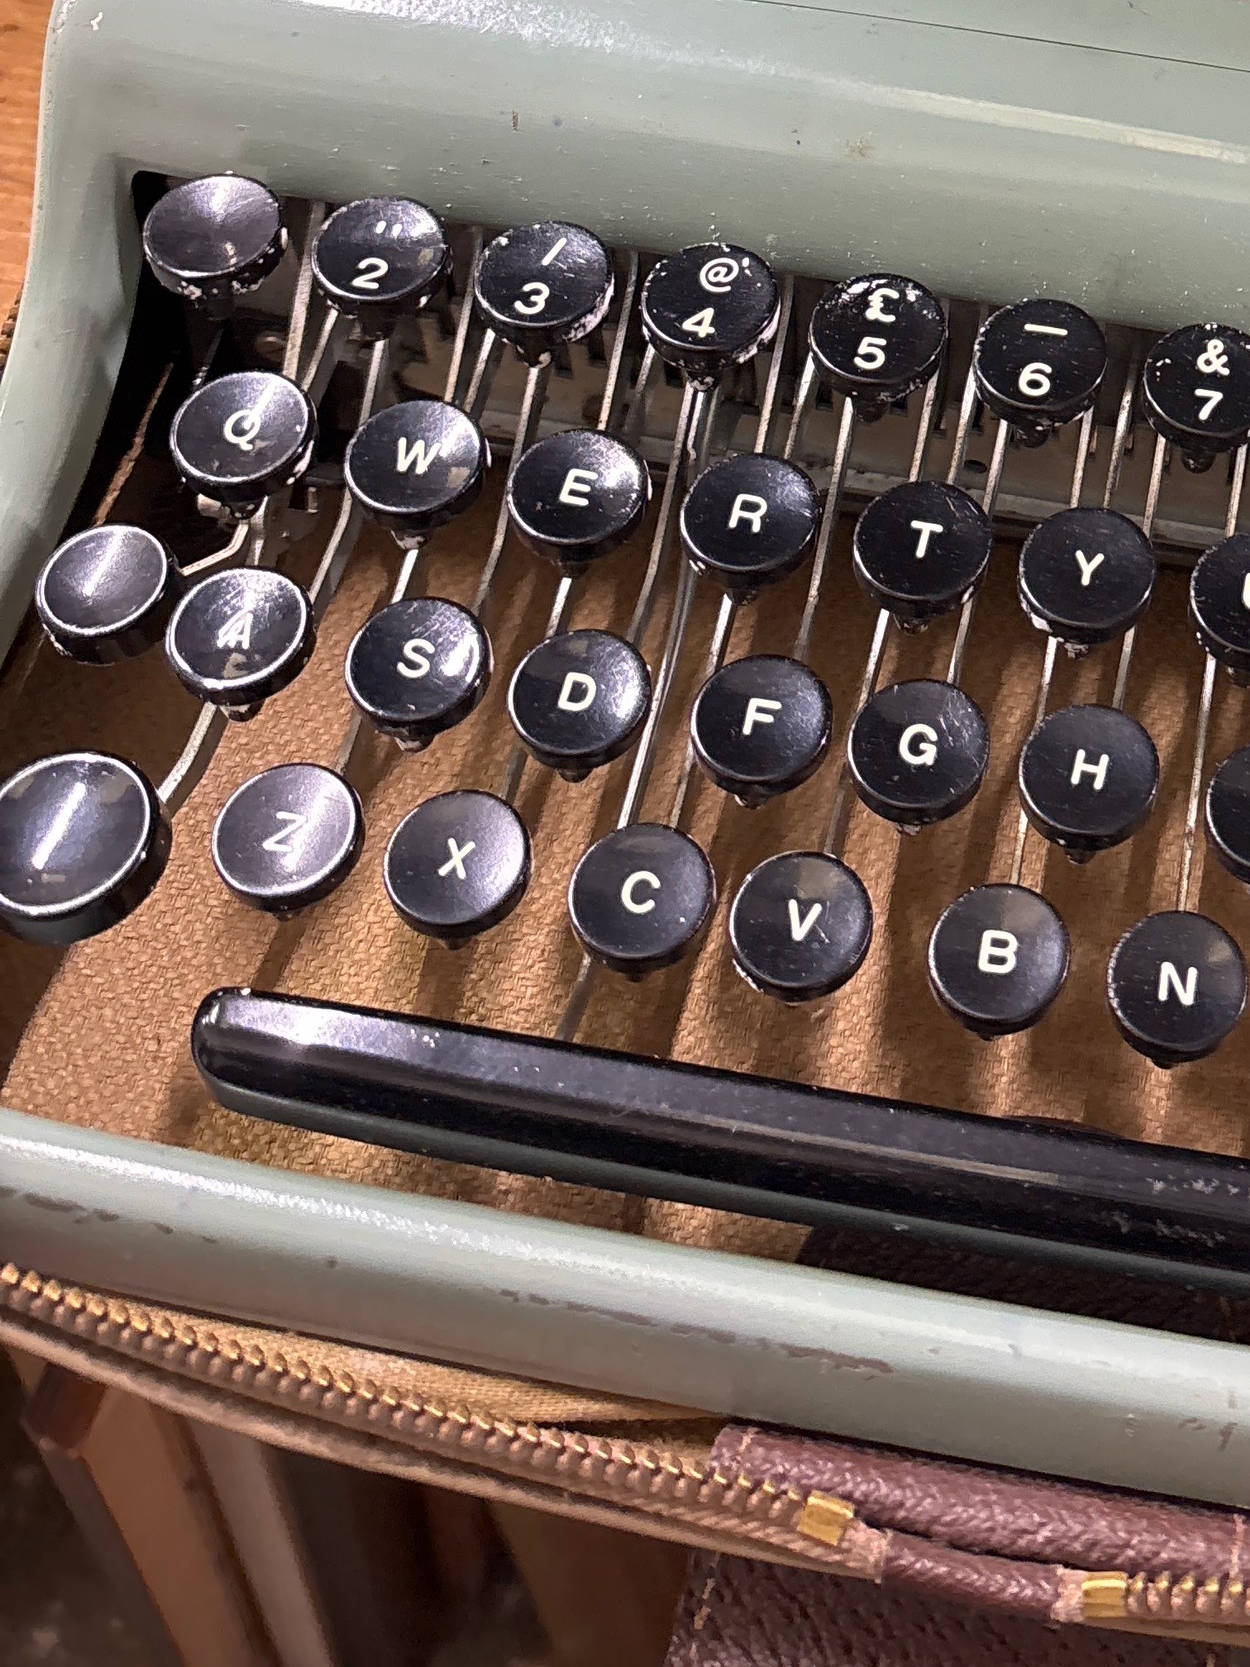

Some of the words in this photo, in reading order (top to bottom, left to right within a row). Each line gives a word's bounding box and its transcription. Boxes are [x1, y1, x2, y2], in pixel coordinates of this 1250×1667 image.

[351, 258, 388, 289] 2
[513, 283, 549, 315] 3
[682, 308, 714, 338] 4
[854, 337, 886, 370] 5
[1018, 363, 1052, 396] 6
[1194, 389, 1223, 420] 7
[699, 257, 740, 292] @
[865, 289, 899, 324] £
[1197, 339, 1230, 375] &
[224, 411, 260, 451] Q
[397, 438, 441, 474] W
[558, 469, 598, 507] E
[728, 493, 767, 532] R
[911, 520, 943, 558] T
[1075, 550, 1104, 586] Y
[216, 610, 253, 651] A
[396, 639, 436, 678] S
[557, 672, 597, 712] D
[742, 698, 782, 735] F
[899, 724, 938, 766] G
[1070, 749, 1109, 790] H
[262, 811, 307, 852] Z
[438, 837, 476, 880] X
[620, 871, 661, 914] C
[787, 898, 822, 942] V
[978, 929, 1018, 974] B
[1157, 961, 1197, 1006] N
